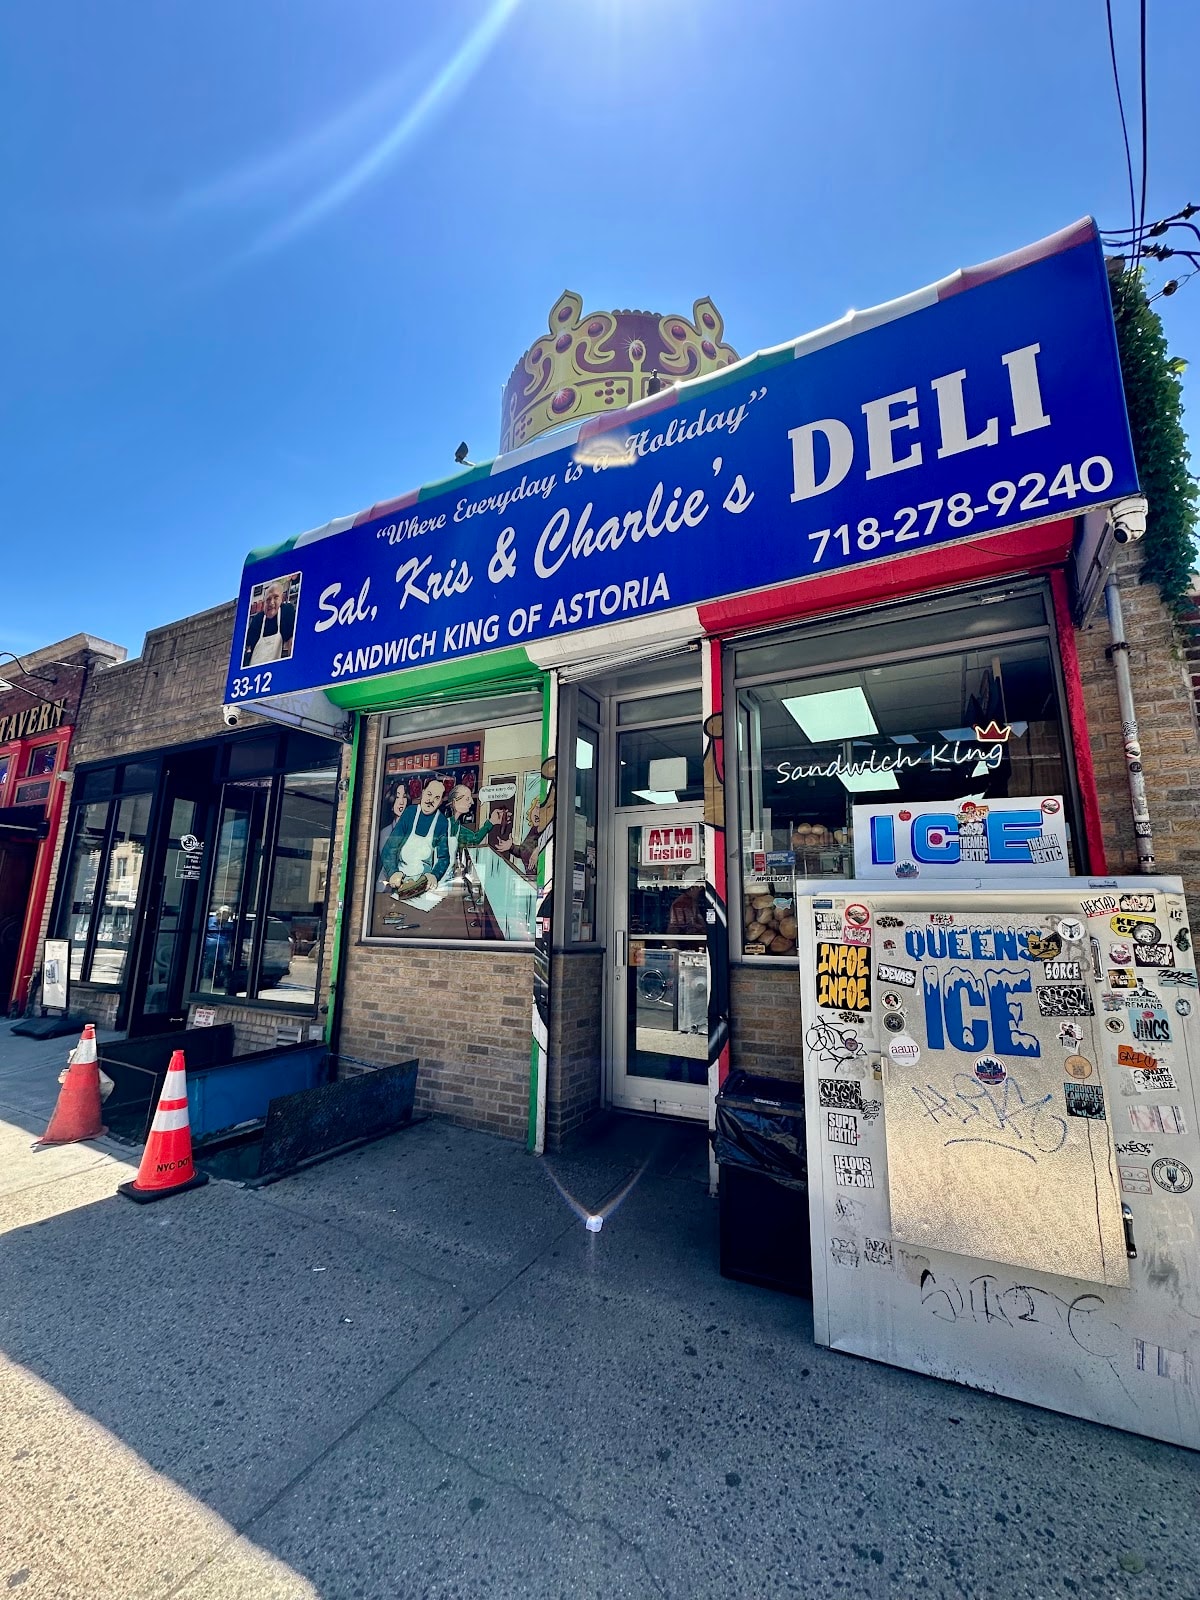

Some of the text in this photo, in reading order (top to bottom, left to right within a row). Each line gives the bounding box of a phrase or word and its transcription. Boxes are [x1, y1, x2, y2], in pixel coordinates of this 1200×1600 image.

[788, 343, 1051, 503] DELI
[453, 475, 557, 523] Everyday
[565, 461, 583, 483] is
[593, 453, 609, 473] a
[808, 455, 1114, 563] 718-278-9240
[315, 576, 378, 632] Sal,
[396, 555, 473, 610] Kris
[488, 526, 517, 583] &
[331, 573, 670, 677] SANDWICH KING OF ASTORIA
[230, 671, 273, 698] 33-12
[0, 698, 66, 741] TAVERN
[777, 741, 1003, 784] Sandwich King
[649, 828, 693, 846] ATM
[869, 809, 1043, 865] ICE
[1080, 895, 1116, 916] HEKTAD
[905, 923, 1042, 961] QUEENS
[818, 943, 869, 977] INFOE
[1045, 962, 1079, 980] SORCE
[818, 974, 869, 1009] INFOE
[923, 965, 1041, 1057] ICE
[891, 1045, 919, 1058] aaup
[1065, 1083, 1103, 1095] BROOKLYN
[828, 1113, 856, 1130] SUPA
[828, 1126, 857, 1145] HEKTIC
[156, 1162, 176, 1173] NYC
